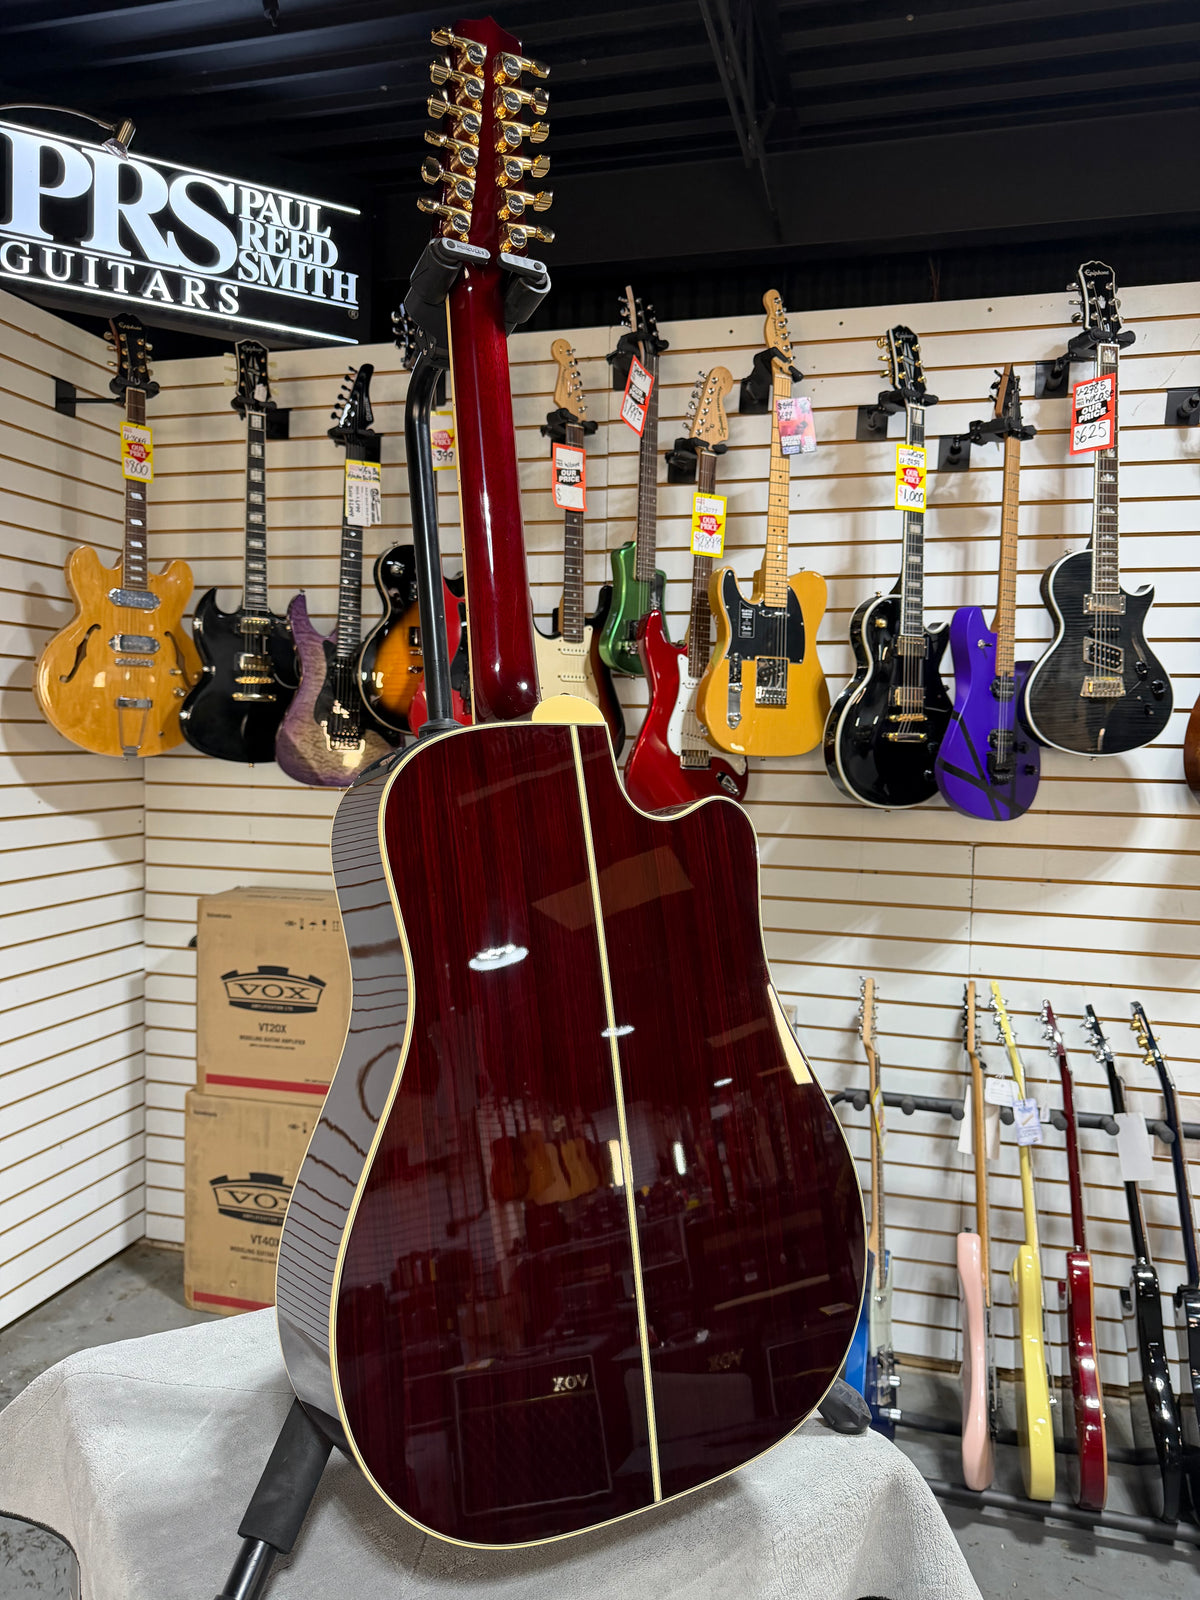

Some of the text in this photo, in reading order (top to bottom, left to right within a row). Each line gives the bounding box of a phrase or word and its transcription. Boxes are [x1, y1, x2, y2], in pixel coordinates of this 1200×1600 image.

[0, 127, 239, 275] PRS
[238, 186, 332, 239] PAUL
[238, 217, 339, 268] REED
[0, 240, 240, 315] GUITARS
[237, 250, 360, 305] SMITH
[1078, 407, 1107, 424] PRICE
[1081, 402, 1102, 415] OUR
[1075, 421, 1107, 446] $625
[125, 458, 149, 476] $800
[905, 468, 919, 477] OUR
[558, 475, 581, 483] PRICE
[904, 475, 921, 485] PRICE
[700, 523, 719, 532] PRICE
[702, 516, 717, 525] OUR
[234, 983, 310, 1000] VOX
[258, 1022, 287, 1033] VT20X
